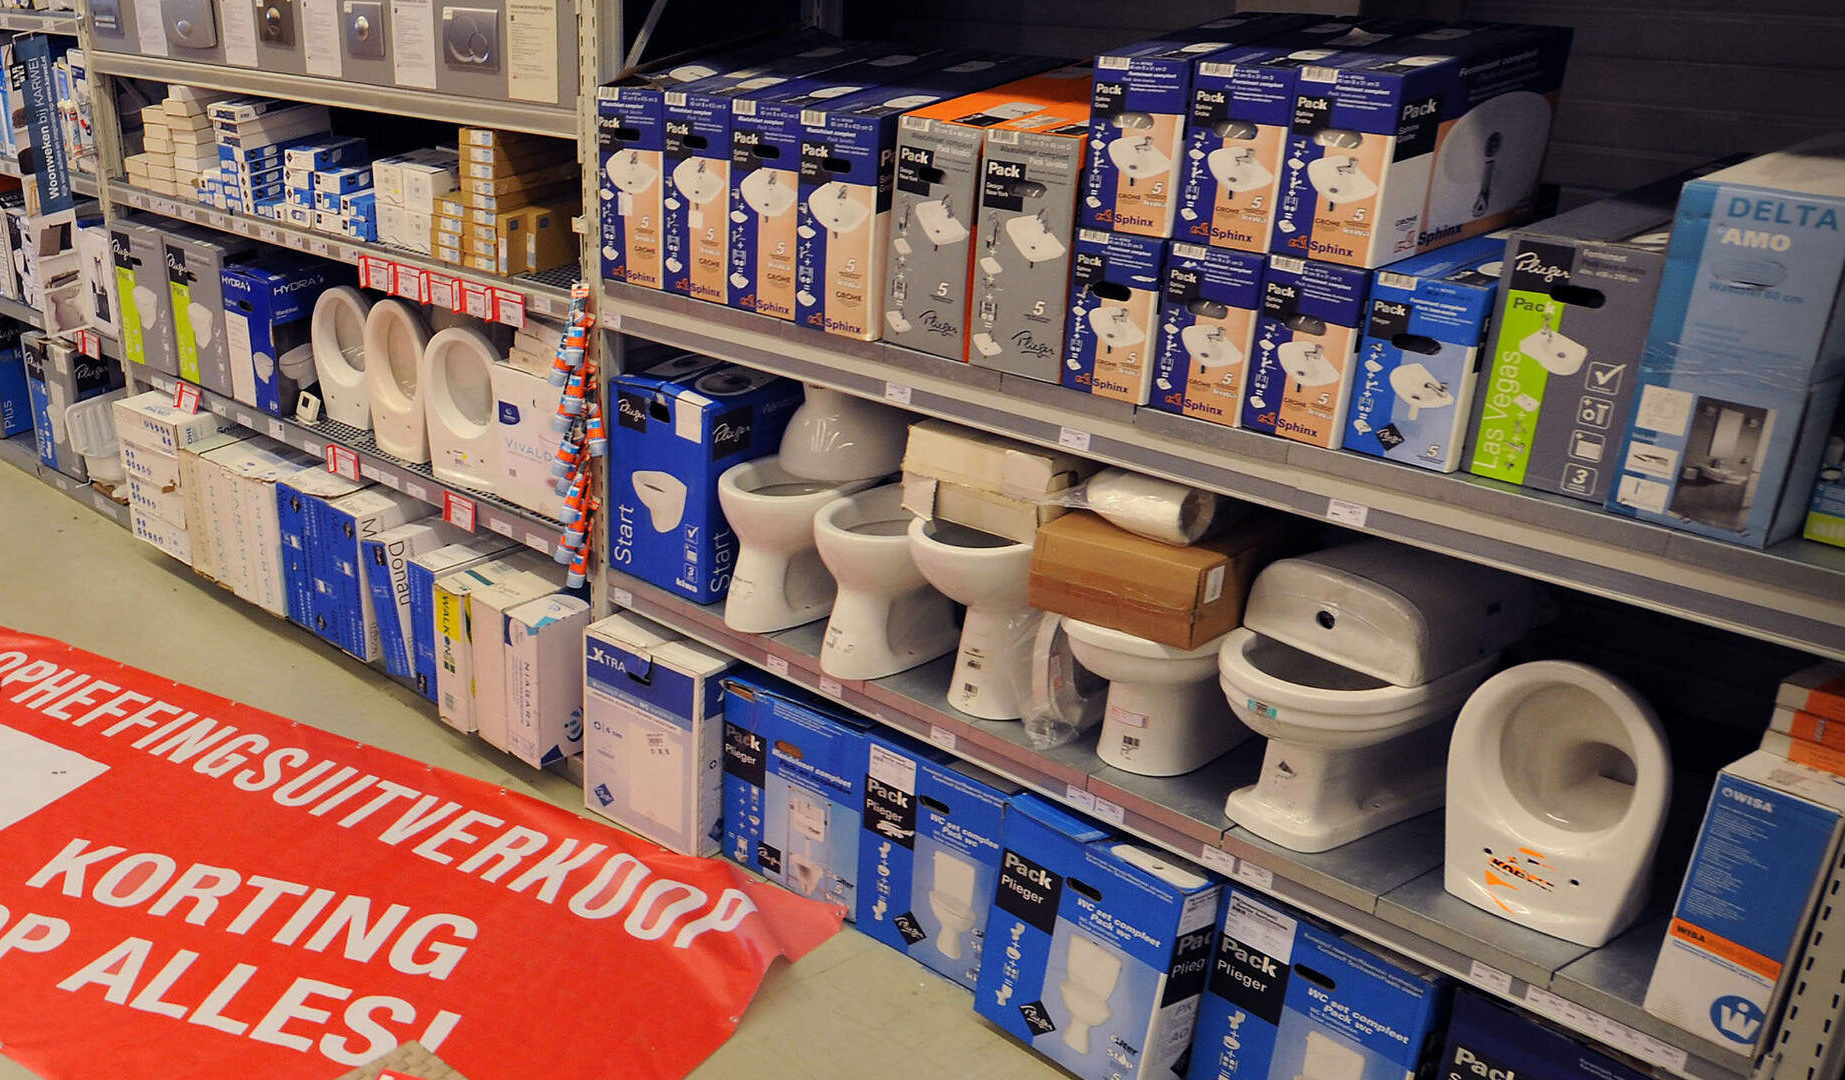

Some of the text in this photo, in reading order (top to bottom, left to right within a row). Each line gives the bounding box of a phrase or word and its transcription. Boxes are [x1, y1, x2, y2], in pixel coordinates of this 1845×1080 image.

[28, 57, 45, 107] KARWEI
[1096, 83, 1122, 96] Pack
[1196, 90, 1225, 104] Pack
[1297, 95, 1328, 111] Pack
[1402, 98, 1437, 121] Pack
[599, 116, 620, 129] Pack
[666, 122, 689, 136] Pack
[733, 131, 759, 145] Pack
[802, 143, 829, 158] Pack
[901, 148, 929, 164] Pack
[41, 125, 58, 200] Woonweken
[987, 162, 1021, 178] Pack
[1115, 213, 1154, 228] Sphinx
[1726, 196, 1839, 231] DELTA
[1211, 227, 1253, 243] Sphinx
[1417, 223, 1464, 247] Sphinx
[1721, 228, 1791, 252] AMO
[1310, 240, 1354, 258] Sphinx
[1077, 253, 1102, 267] Pack
[1515, 251, 1571, 282] Plieger
[222, 275, 246, 291] HYDRA
[626, 269, 656, 283] Sphinx
[1170, 269, 1197, 284] Pack
[273, 278, 316, 296] HYDRA
[690, 282, 720, 297] Sphinx
[937, 282, 949, 296] 5
[1267, 282, 1296, 298] Pack
[756, 299, 790, 315] Sphinx
[1033, 301, 1046, 316] 5
[1374, 301, 1406, 316] Pack
[1513, 297, 1555, 315] Pack
[825, 318, 862, 334] Sphinx
[1092, 379, 1129, 394] Sphinx
[1184, 398, 1223, 416] Sphinx
[1473, 351, 1522, 469] Las Vegas
[1276, 418, 1318, 438] Sphinx
[505, 438, 553, 462] VIVALD
[1426, 445, 1440, 457] 5
[1572, 468, 1588, 485] 3
[614, 504, 634, 565] Start
[710, 528, 730, 593] Start
[388, 540, 411, 607] Donau
[588, 646, 626, 673] XTRA
[725, 724, 760, 752] Pack
[724, 744, 757, 766] Plieger
[867, 778, 909, 809] Pack
[1733, 790, 1774, 814] WISA
[866, 799, 903, 822] Plieger
[930, 813, 945, 826] WC
[961, 826, 1000, 850] complee
[941, 826, 963, 843] Pack
[1005, 852, 1052, 891] Pack
[1001, 874, 1044, 905] Plieger
[25, 838, 480, 982] KORTING
[1077, 897, 1162, 948] WC set compleet
[1090, 912, 1115, 935] Pack
[1178, 932, 1212, 955] Pac
[1676, 924, 1706, 944] WISA
[1221, 936, 1278, 978] Pack
[1172, 957, 1209, 979] Plieg
[1217, 959, 1267, 993] Plieger
[57, 937, 462, 1069] ALLES!
[1308, 987, 1410, 1045] WC set compleet
[1323, 1004, 1352, 1026] Pack
